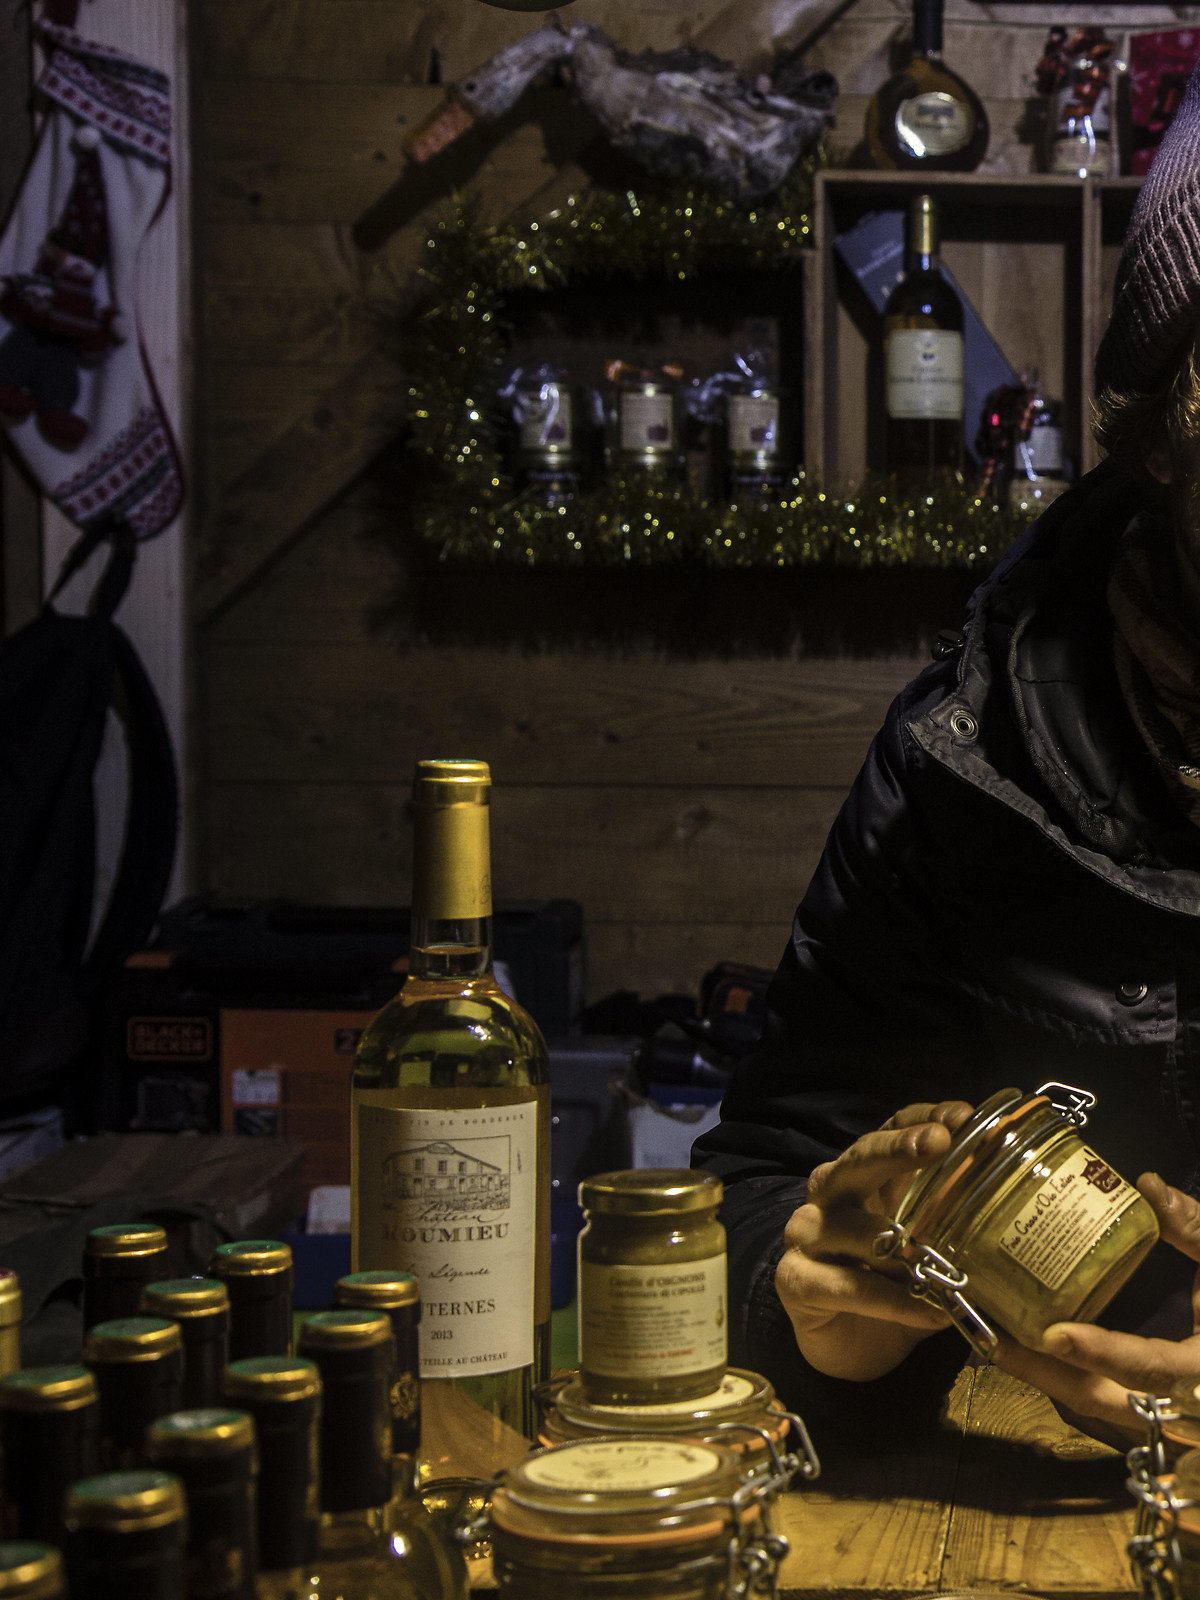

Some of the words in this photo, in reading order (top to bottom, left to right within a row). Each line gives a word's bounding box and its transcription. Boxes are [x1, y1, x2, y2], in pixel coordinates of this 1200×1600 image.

[1000, 1235, 1021, 1253] Foie
[1015, 1214, 1038, 1235] Gras
[1036, 1192, 1058, 1216] d'Oie
[382, 1222, 510, 1243] ROUMIEU
[420, 1298, 497, 1317] TERNES
[430, 1329, 454, 1341] 2013
[456, 1356, 468, 1366] AU
[470, 1351, 508, 1364] CHÂTEAU
